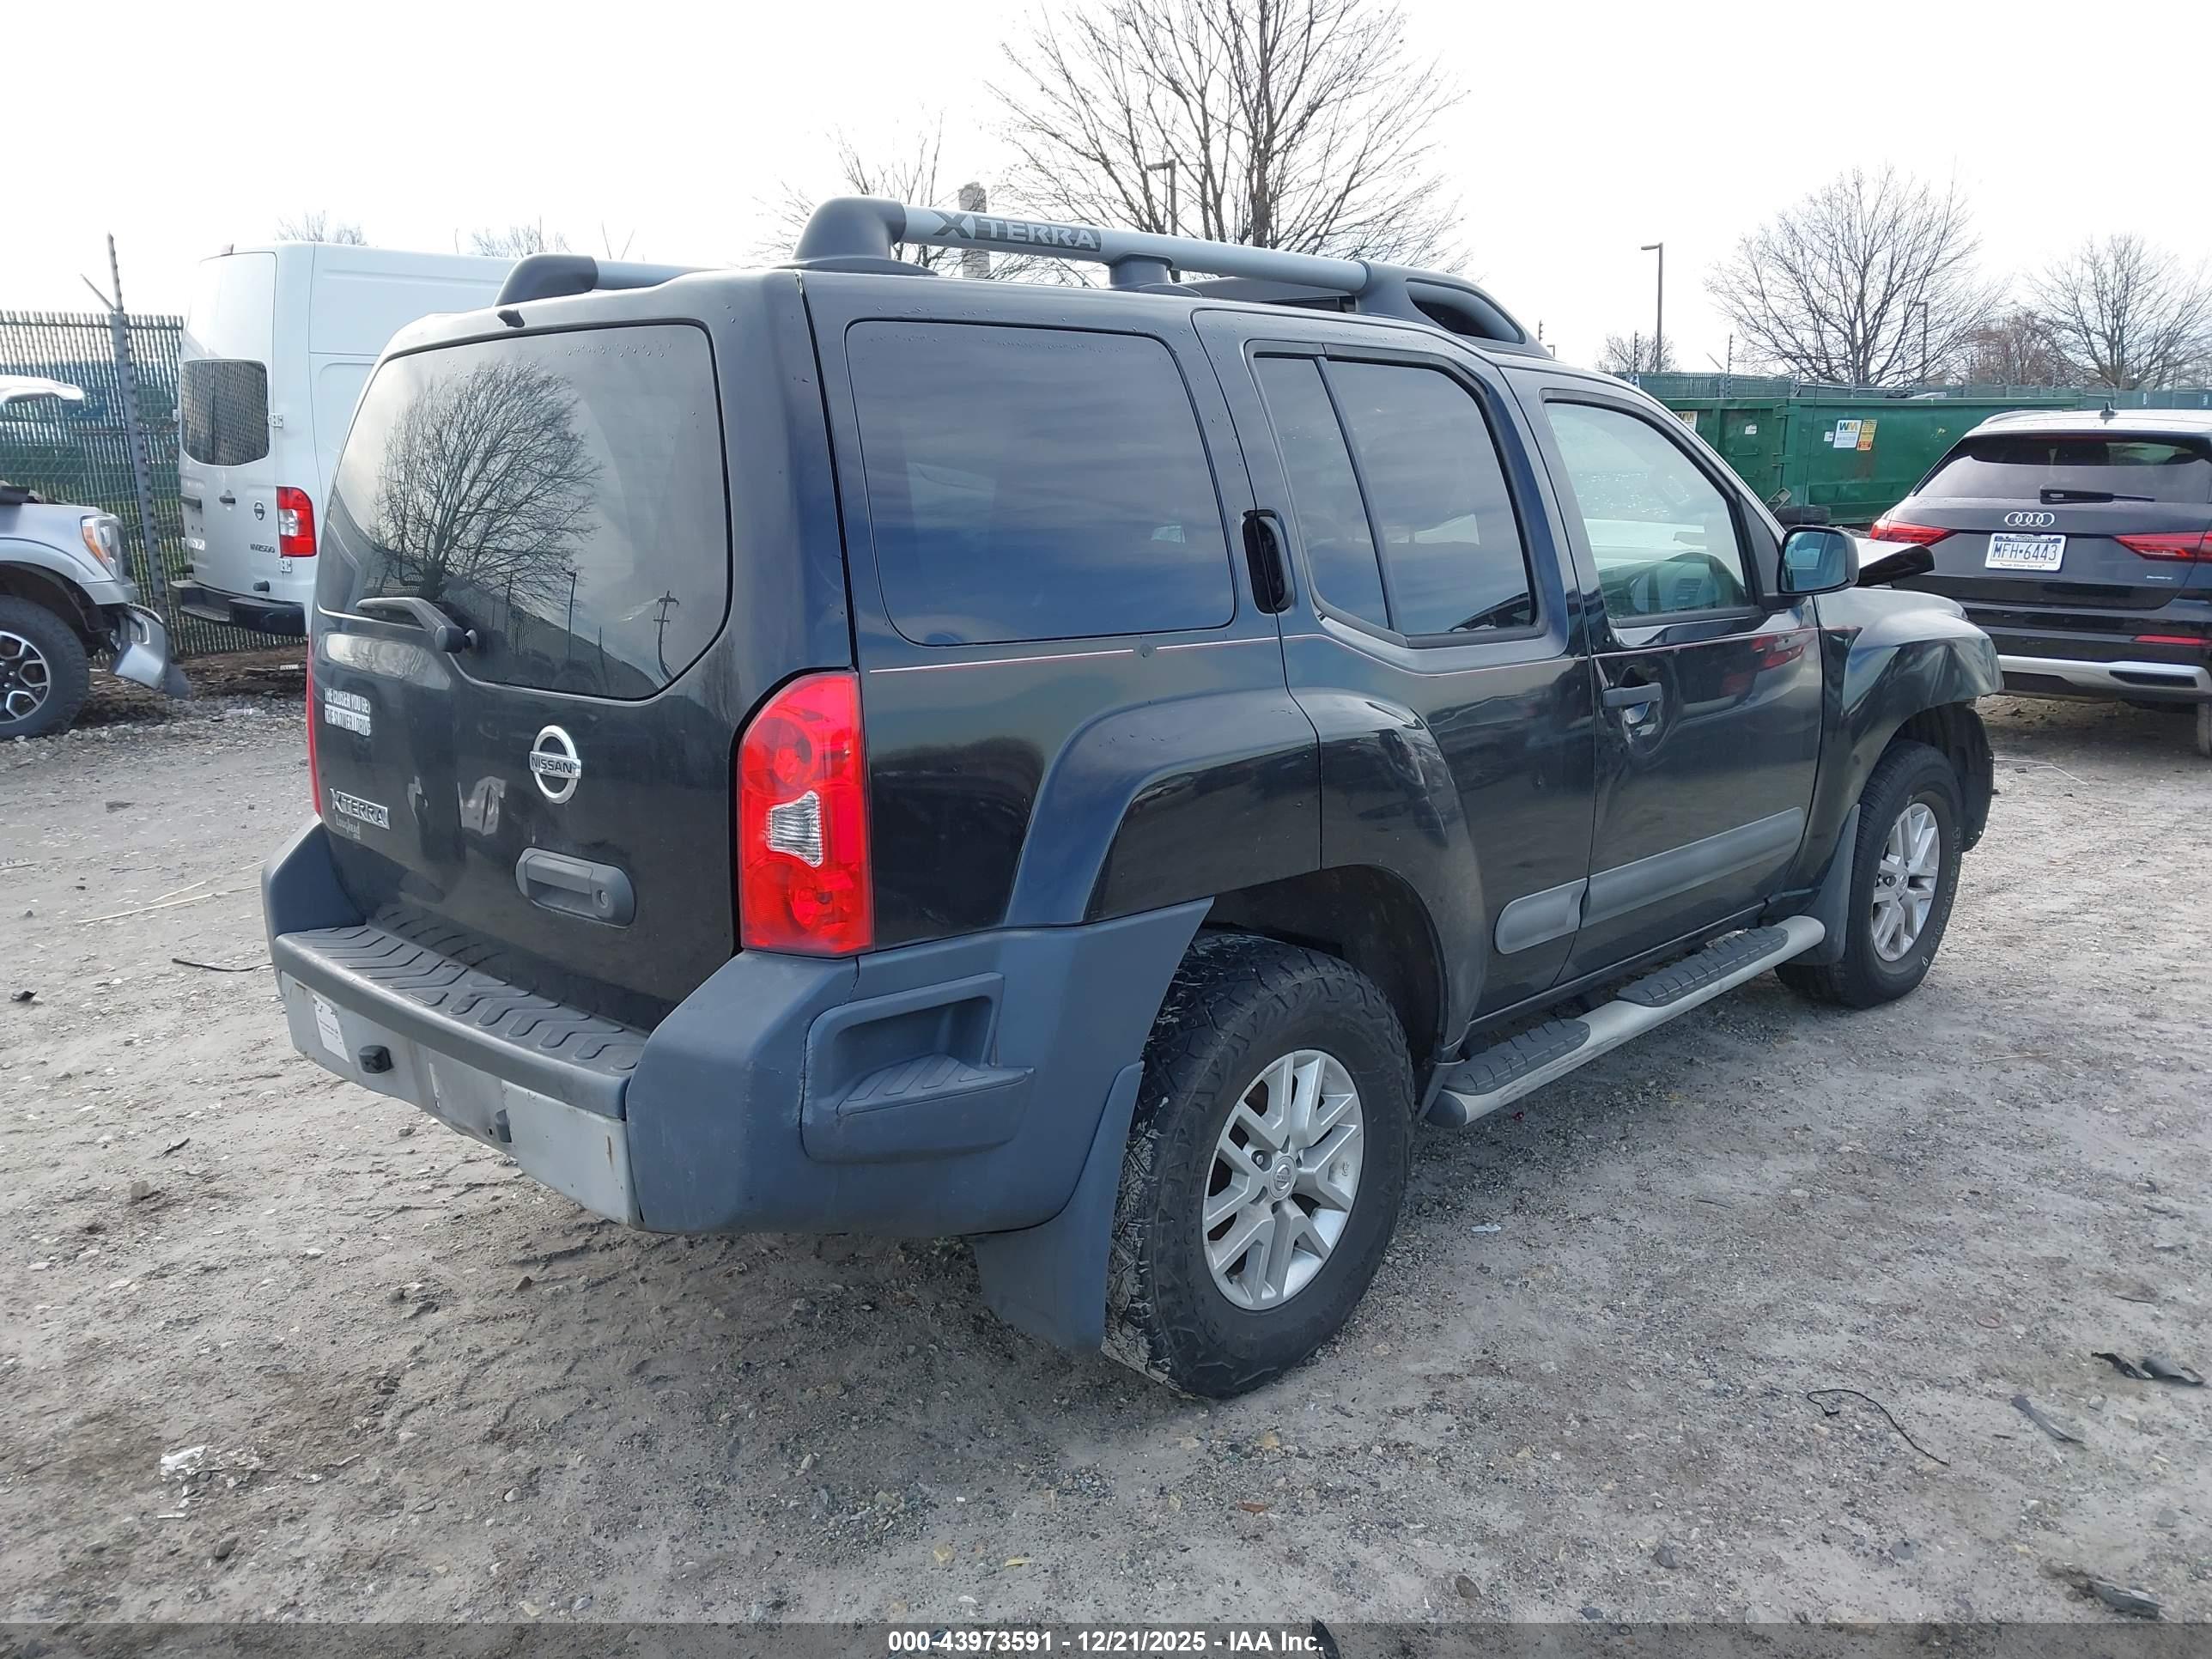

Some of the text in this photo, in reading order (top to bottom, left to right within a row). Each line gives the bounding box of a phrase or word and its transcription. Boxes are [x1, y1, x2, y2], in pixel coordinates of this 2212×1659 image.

[931, 210, 1097, 249] XTERRA
[1838, 422, 1858, 431] WM
[1992, 543, 2058, 562] MFH-6443
[532, 757, 573, 775] NISSAN
[330, 787, 391, 830] XTERRA
